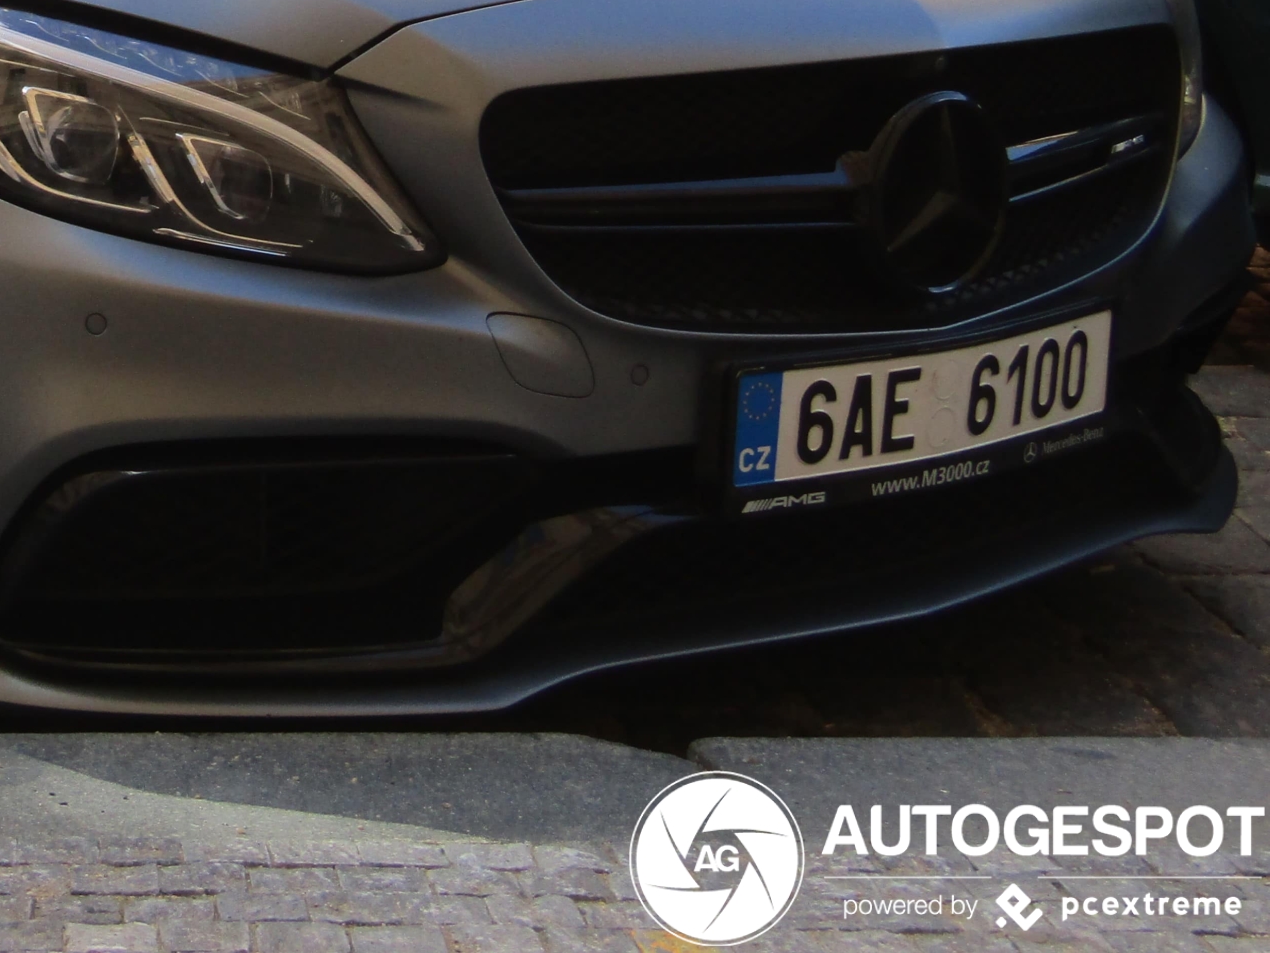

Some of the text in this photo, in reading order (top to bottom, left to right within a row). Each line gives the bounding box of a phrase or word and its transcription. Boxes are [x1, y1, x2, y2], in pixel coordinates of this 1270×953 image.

[796, 328, 1089, 465] 6AE 6100
[1042, 427, 1104, 454] Mercedes-Benz
[738, 445, 771, 473] CZ
[871, 460, 990, 497] www.M3000.cz
[766, 491, 826, 511] AMG
